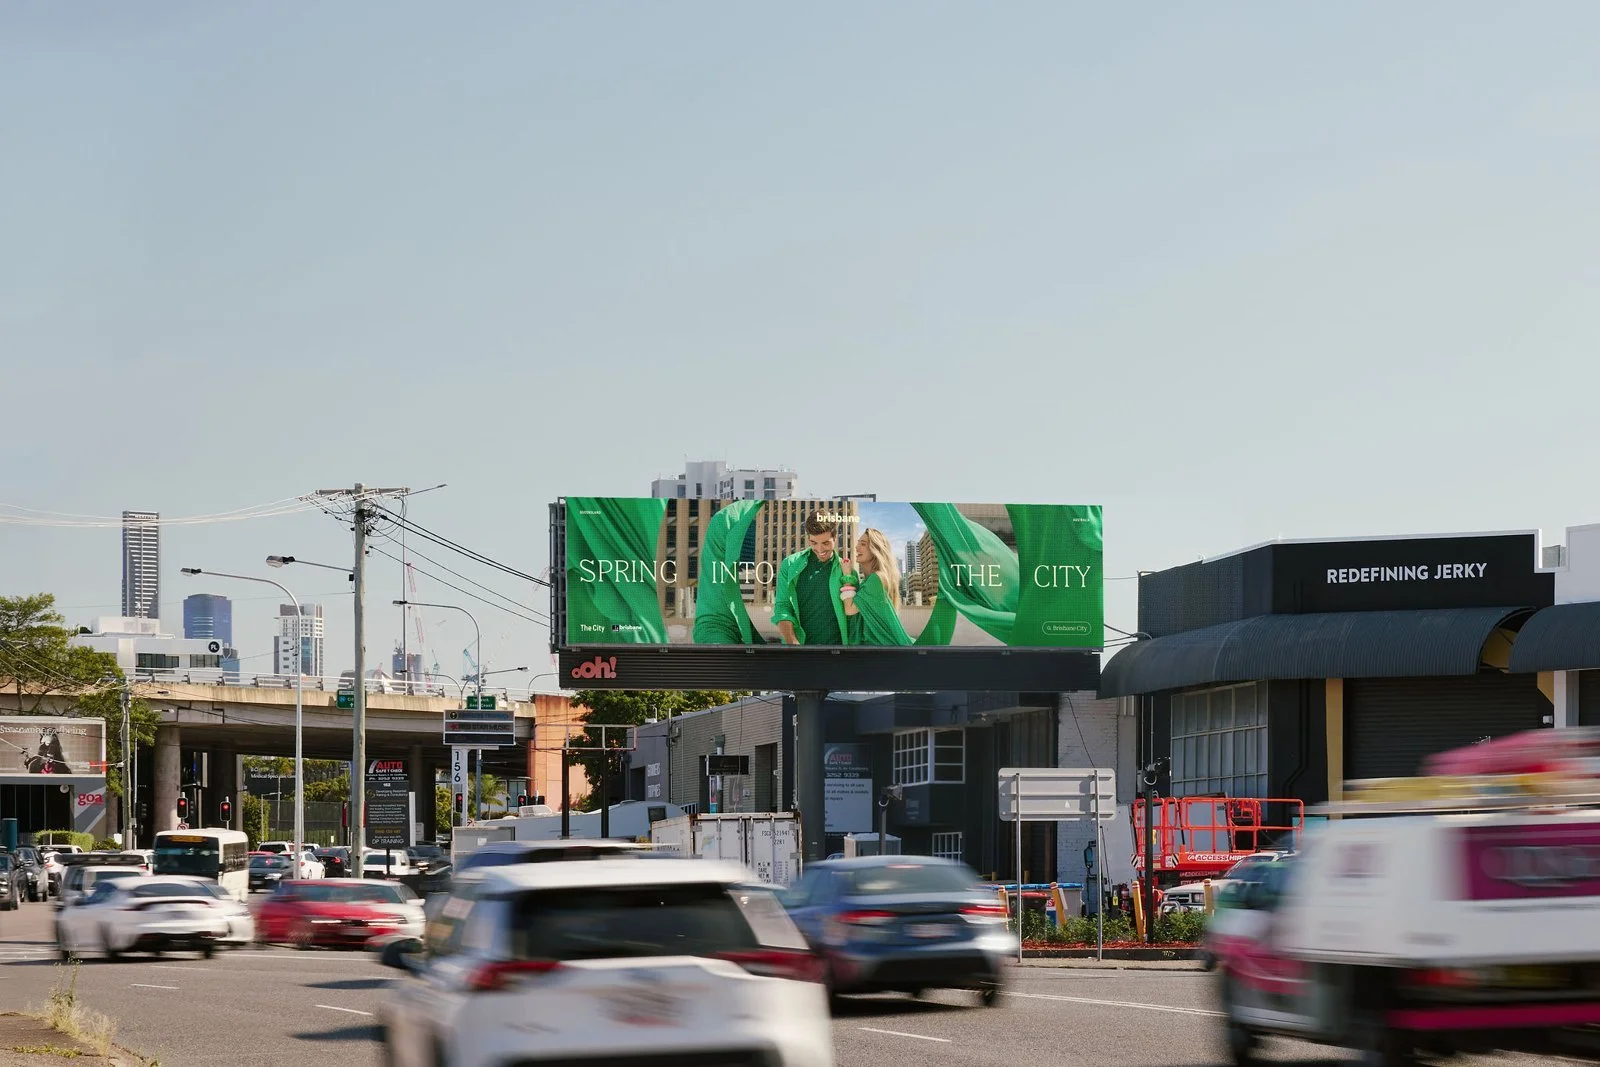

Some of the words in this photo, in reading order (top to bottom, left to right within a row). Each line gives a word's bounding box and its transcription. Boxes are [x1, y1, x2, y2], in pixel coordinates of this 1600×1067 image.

[816, 512, 860, 523] brisbane
[579, 559, 677, 584] SPRING
[711, 561, 774, 584] INTO
[951, 564, 1002, 587] THE
[1034, 565, 1091, 588] CITY
[1327, 565, 1429, 584] REDEFINING
[1434, 562, 1487, 580] JERKY
[580, 624, 592, 632] The
[592, 624, 605, 633] City
[376, 761, 403, 769] AUTO
[78, 794, 104, 806] goa
[1196, 854, 1229, 862] ACCESS
